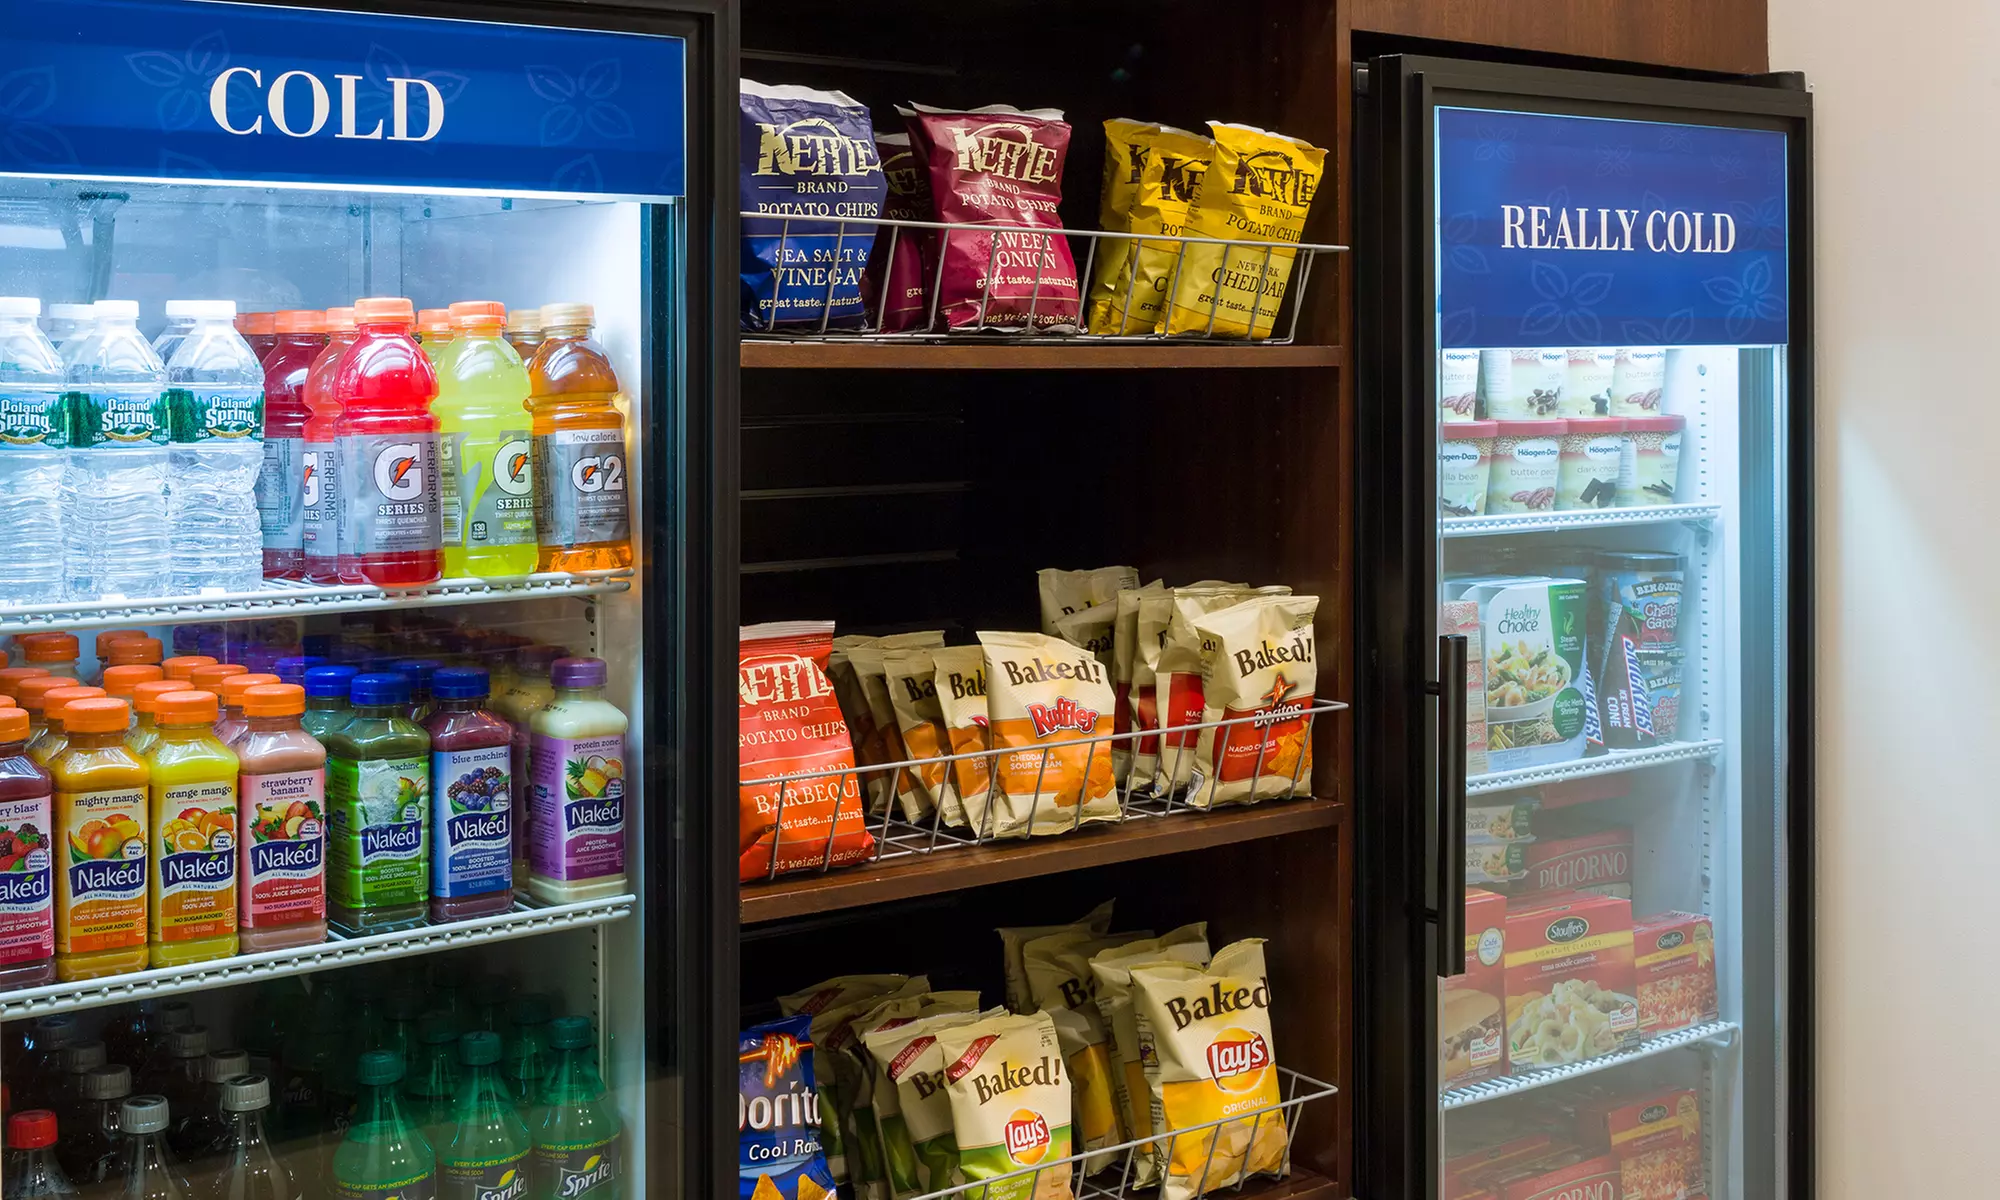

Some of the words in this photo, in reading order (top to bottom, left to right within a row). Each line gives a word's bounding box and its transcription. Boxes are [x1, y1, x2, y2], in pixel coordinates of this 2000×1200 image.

[209, 66, 445, 141] COLD
[752, 117, 882, 176] KETTLE
[946, 122, 1057, 184] KETTLE
[796, 182, 848, 193] BRAND
[987, 178, 1021, 195] BRAND
[1227, 151, 1316, 208] KETTLE
[757, 202, 829, 217] POTATO
[835, 202, 878, 217] CHIPS
[960, 193, 1015, 210] POTATO
[1017, 197, 1057, 213] CHIPS
[1259, 204, 1292, 220] BRAND
[1226, 213, 1275, 237] POTATO
[1501, 205, 1639, 251] REALLY
[1645, 210, 1736, 253] COLD
[990, 231, 1053, 251] SWEET
[774, 248, 808, 263] SEA
[857, 248, 867, 262] &
[996, 251, 1056, 270] ONION
[1236, 260, 1257, 273] NEW
[1258, 262, 1279, 278] YRK
[1212, 267, 1285, 299] CHEDDAR
[2, 399, 46, 413] Poland
[108, 398, 151, 413] Poland
[211, 396, 251, 411] Poland
[101, 411, 154, 433] Spring
[205, 408, 255, 431] Spring
[572, 433, 589, 442] low
[590, 431, 617, 442] calorie
[373, 442, 423, 501] G
[493, 439, 533, 496] G
[571, 455, 623, 493] G2
[1511, 468, 1539, 477] butter
[1577, 466, 1597, 474] dark
[377, 503, 425, 516] SERIES
[1504, 603, 1541, 620] Healthy
[1498, 617, 1539, 635] Choice
[1233, 637, 1312, 678] Baked!
[1002, 657, 1102, 687] Baked!
[1624, 638, 1654, 735] SNICKERS
[763, 704, 810, 722] BRAND
[1025, 696, 1098, 739] Ruffles
[1253, 703, 1303, 729] Doritos
[1607, 696, 1621, 728] CONE
[739, 727, 798, 748] POTATO
[801, 719, 848, 740] CHIPS
[573, 741, 601, 752] protein
[602, 738, 620, 748] zone
[1228, 744, 1253, 753] NACHO
[452, 755, 472, 764] blue
[473, 751, 508, 763] machine
[1049, 752, 1055, 760] &
[1009, 762, 1033, 770] SOUR
[261, 777, 313, 788] strawberry
[271, 786, 305, 796] banana
[75, 796, 111, 807] mighty
[112, 793, 144, 804] mango
[165, 789, 199, 800] orange
[201, 786, 233, 796] mango
[14, 803, 39, 815] blast
[572, 801, 620, 826] Naked
[455, 817, 507, 840] Naked
[367, 830, 417, 851] Naked
[258, 844, 318, 870] Naked
[469, 855, 495, 864] BOOSTED
[789, 855, 824, 868] weight
[77, 863, 141, 891] Naked
[169, 856, 230, 881] Naked
[272, 890, 289, 898] JUICE
[290, 886, 320, 895] SMOOTHIE
[92, 911, 110, 919] JUICE
[111, 907, 144, 917] SMOOTHIE
[199, 901, 216, 909] JUICE
[15, 920, 49, 932] SMOOTHIE
[114, 922, 135, 930] ADDED
[1551, 921, 1584, 939] Stouffer's
[19, 934, 41, 944] ADDED
[1165, 976, 1272, 1031] Baked
[1211, 1037, 1264, 1078] Lay's
[972, 1055, 1061, 1105] Baked!
[1222, 1097, 1269, 1115] ORIGINAL
[1008, 1118, 1049, 1152] Lay's
[749, 1140, 788, 1161] Cool
[484, 1159, 499, 1167] GETS
[480, 1175, 525, 1200] Sprite
[563, 1160, 611, 1197] Sprite
